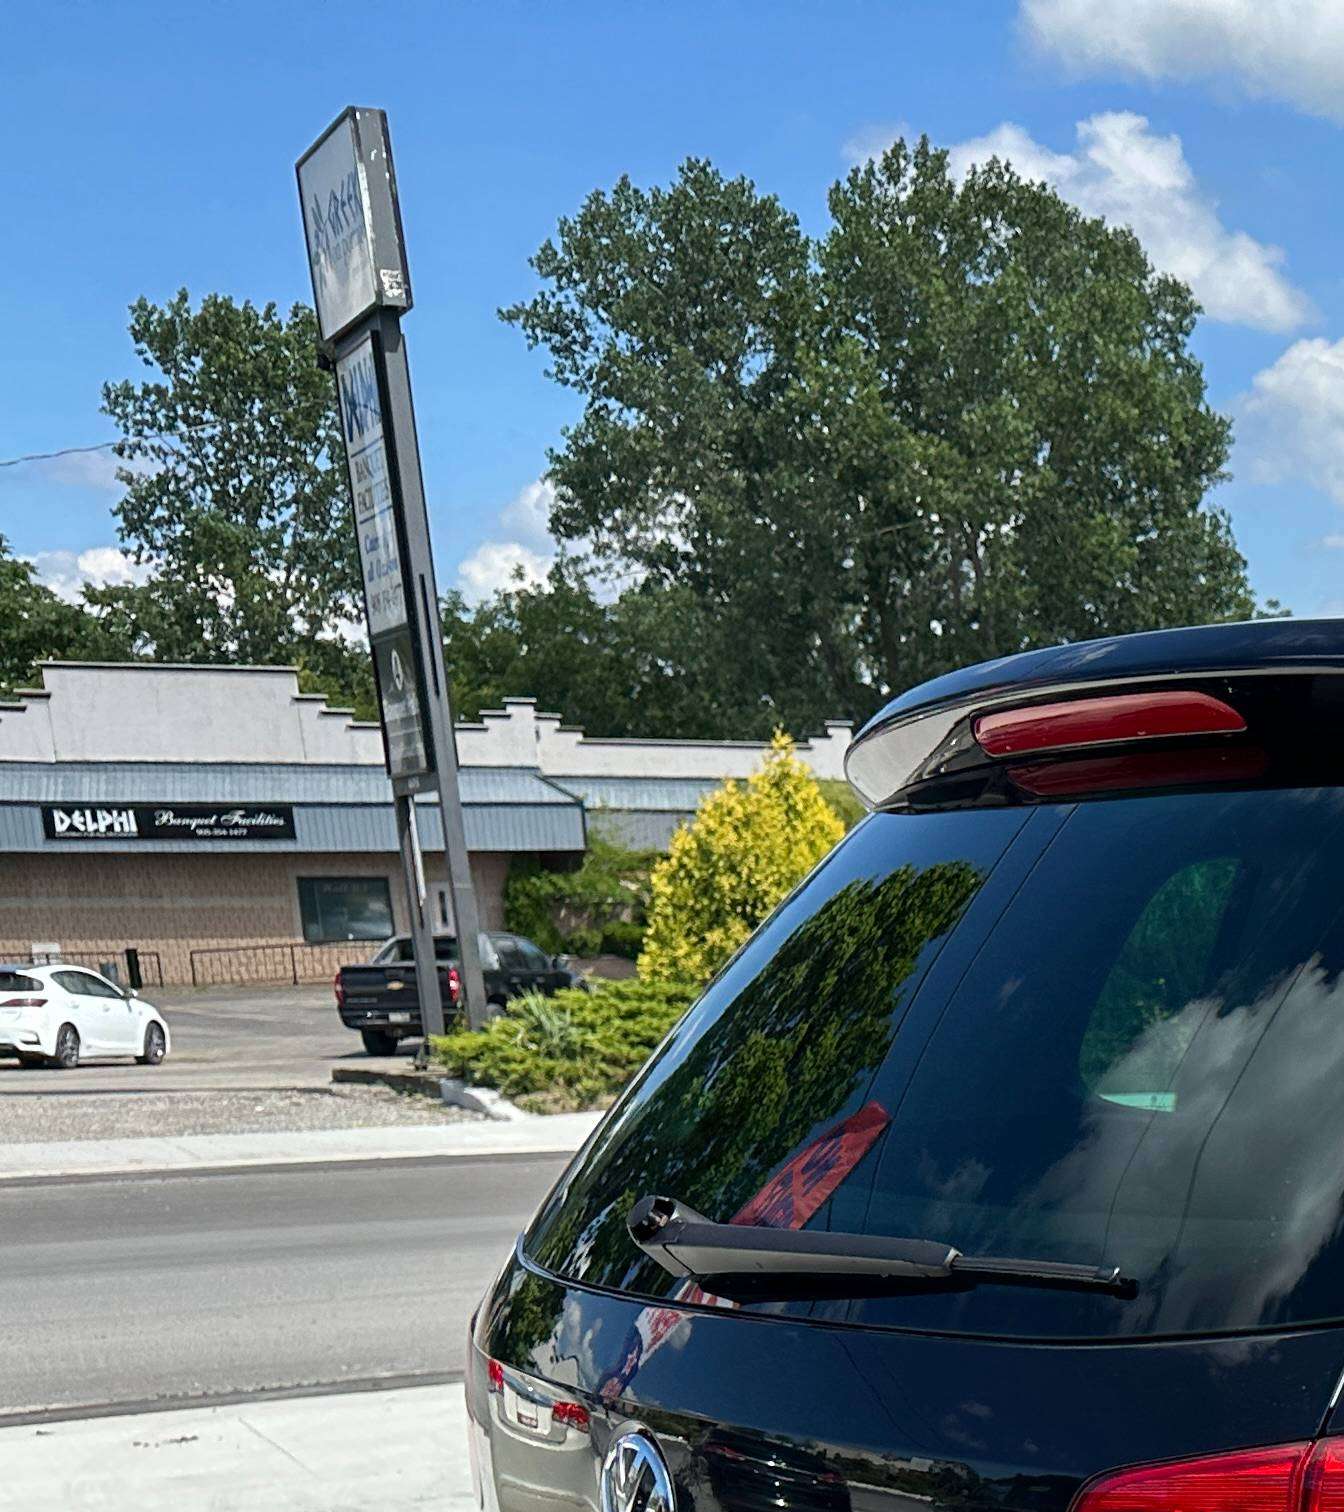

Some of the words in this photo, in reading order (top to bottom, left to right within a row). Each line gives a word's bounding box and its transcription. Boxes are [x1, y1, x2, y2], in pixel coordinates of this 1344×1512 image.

[52, 808, 139, 833] DELPHI
[154, 809, 217, 830] Banquet
[219, 809, 286, 827] Facilities
